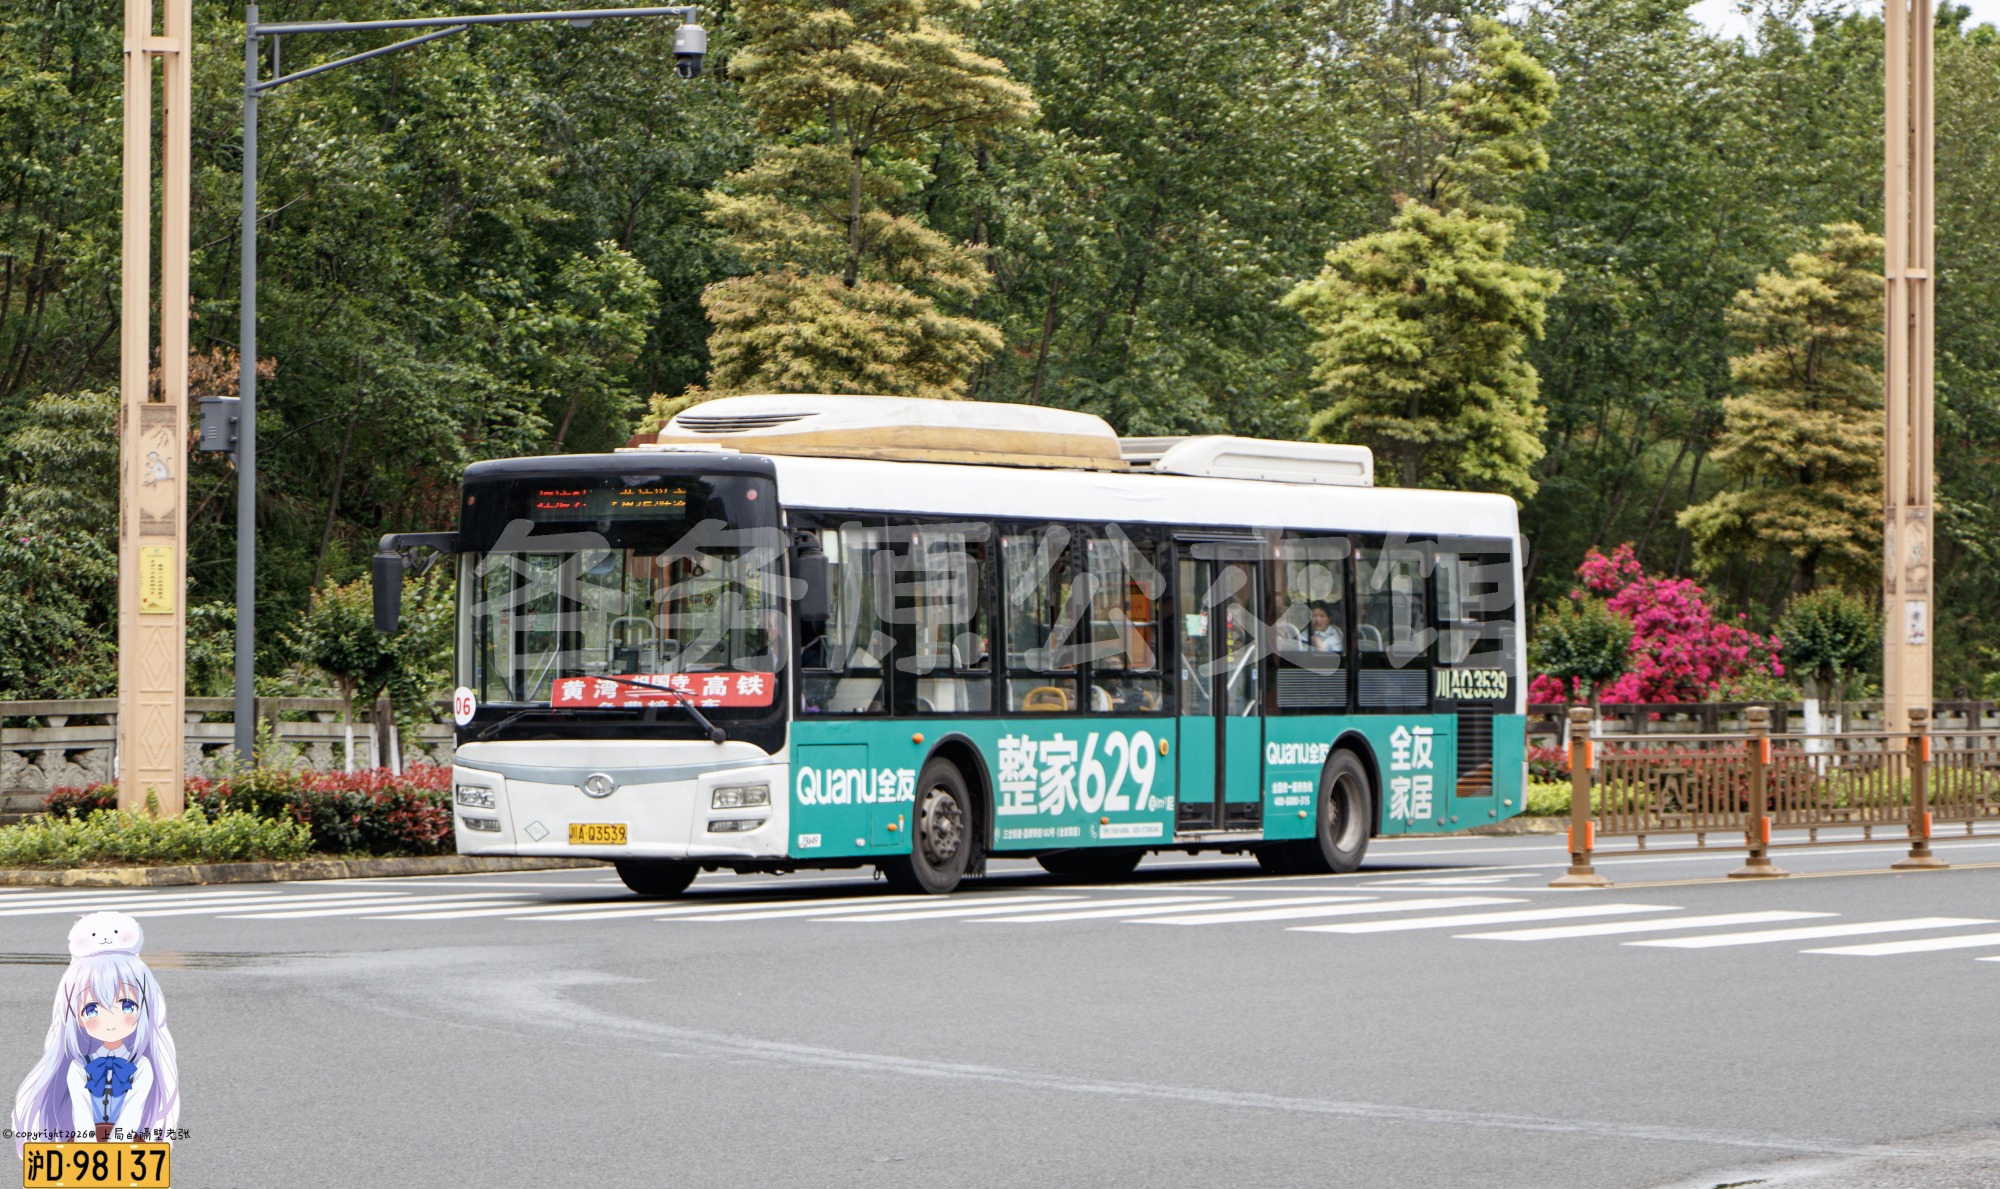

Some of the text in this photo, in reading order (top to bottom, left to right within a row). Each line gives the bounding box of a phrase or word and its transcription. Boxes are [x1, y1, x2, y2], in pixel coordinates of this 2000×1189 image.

[561, 680, 619, 702] 黄湾
[702, 675, 764, 696] 高铁
[1435, 670, 1508, 699] 川AQ3539
[456, 697, 471, 716] 06
[1390, 725, 1434, 771] 全友
[1390, 775, 1434, 820] 家居
